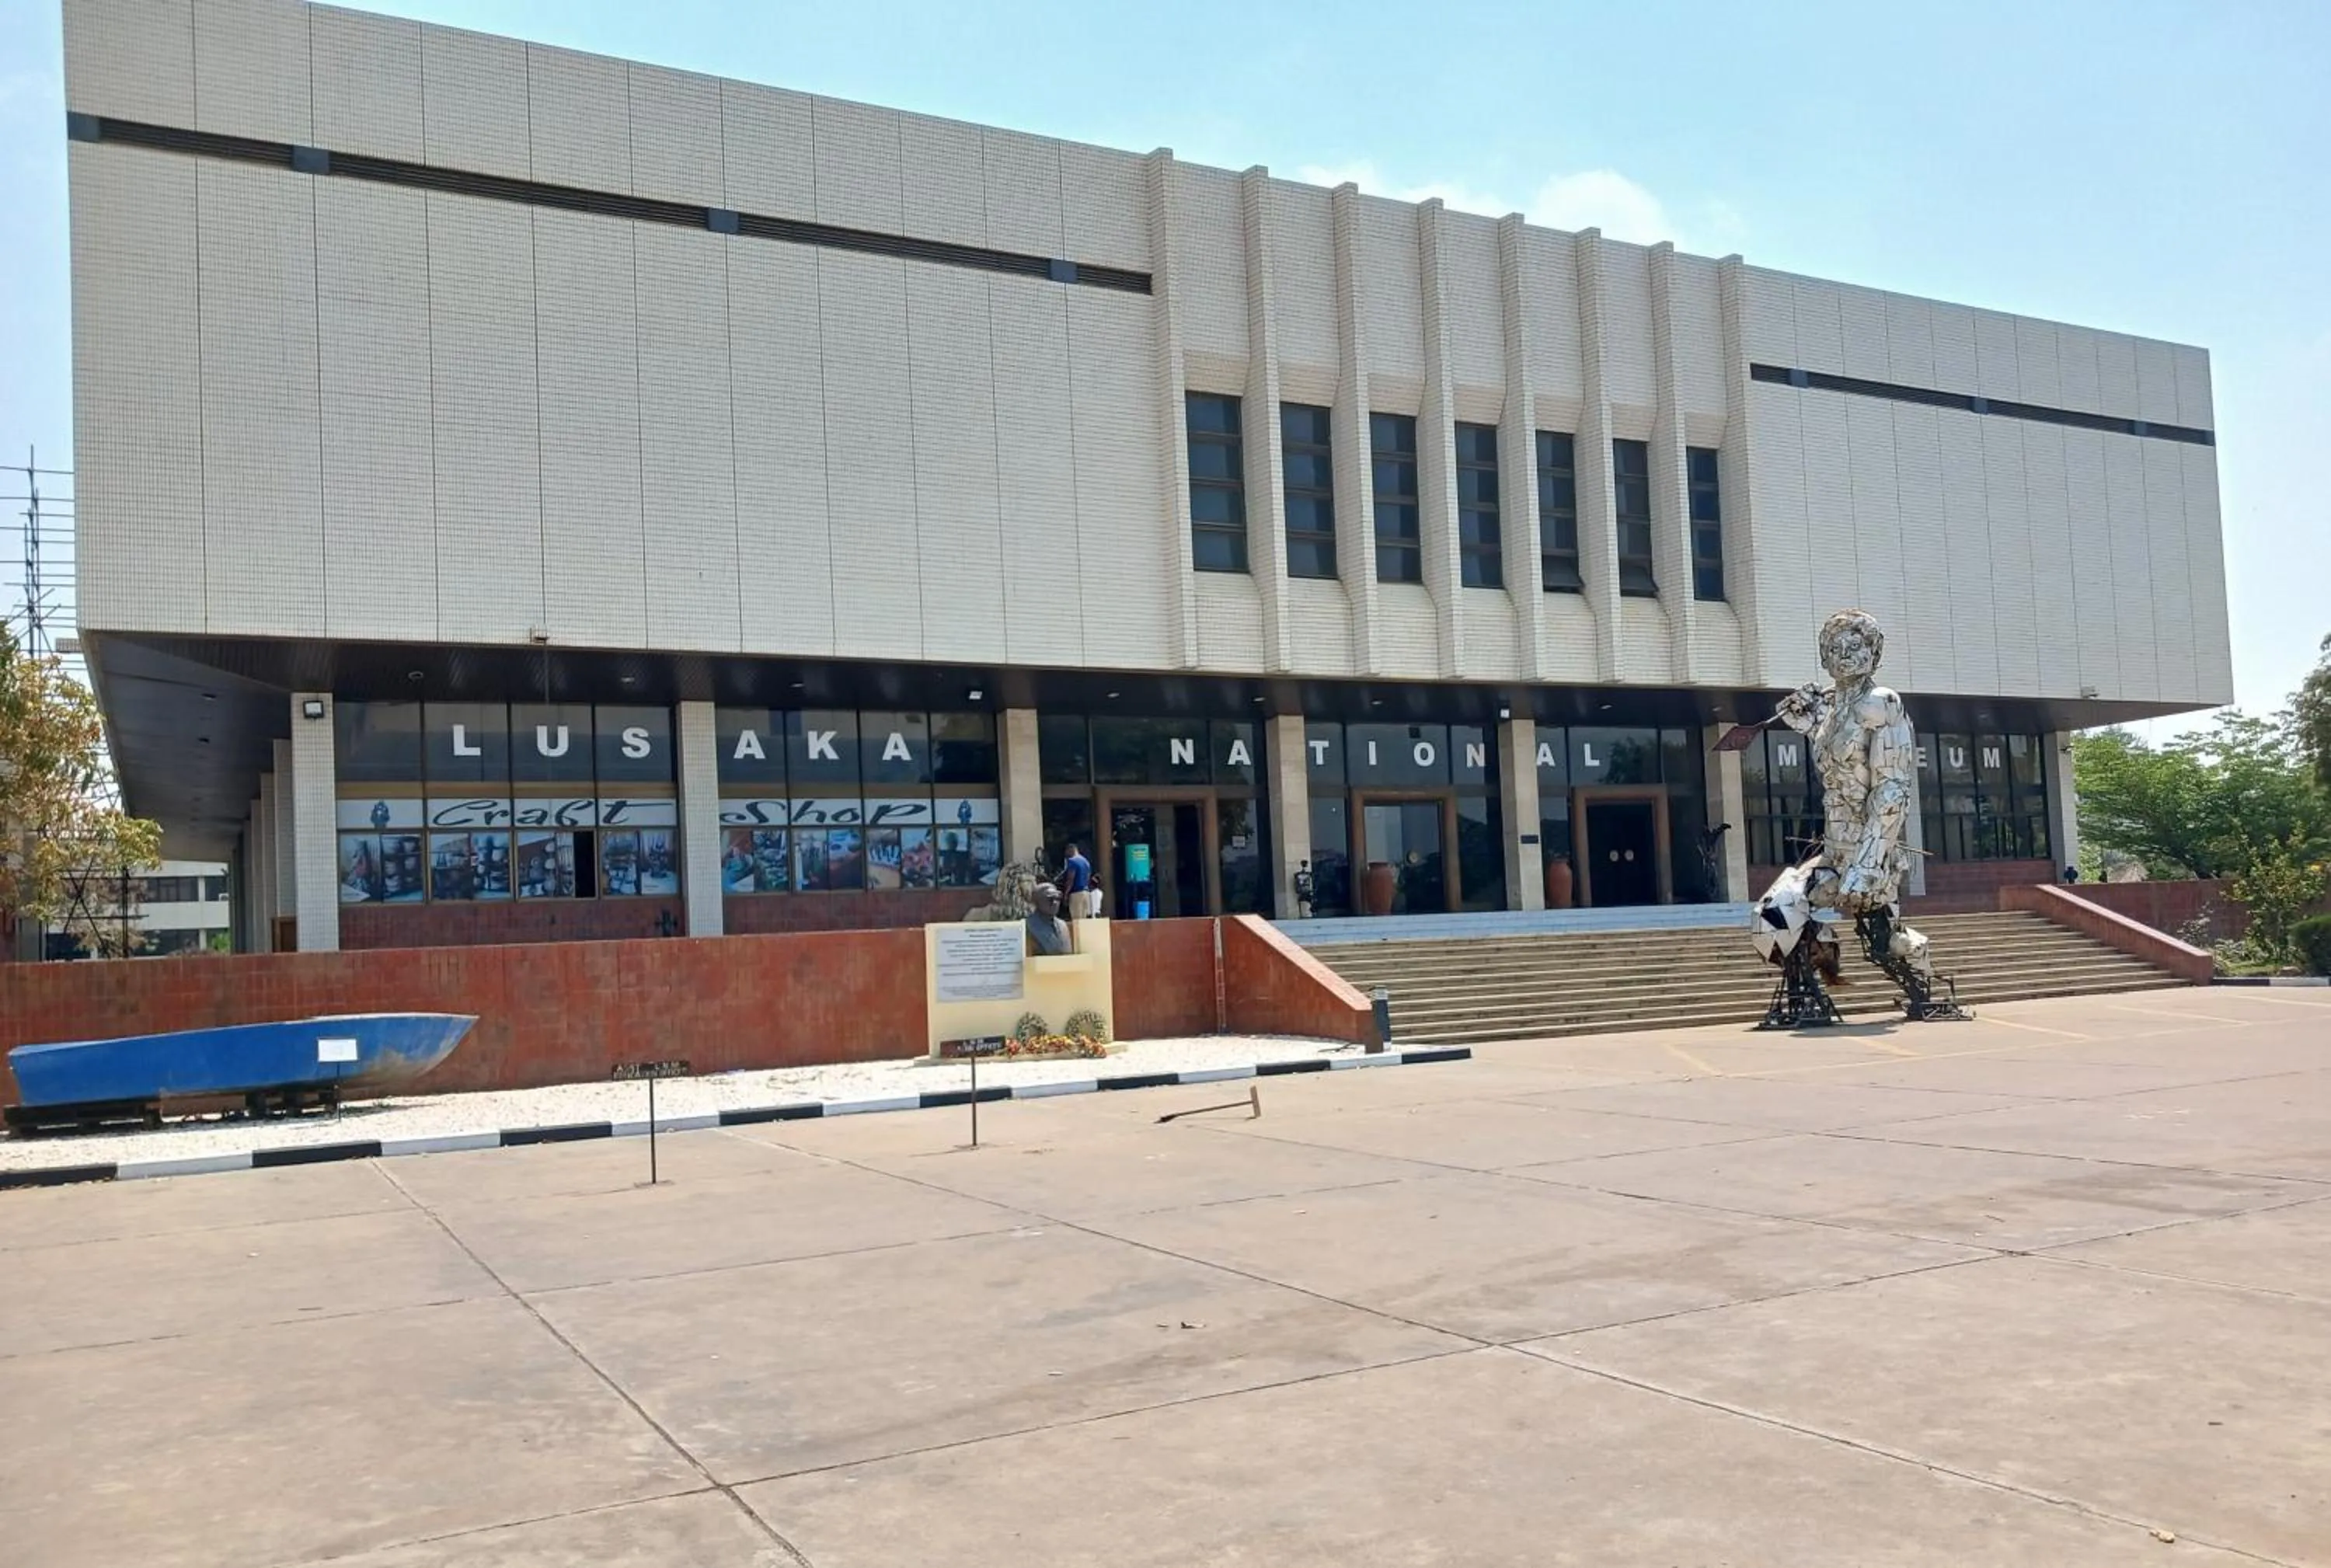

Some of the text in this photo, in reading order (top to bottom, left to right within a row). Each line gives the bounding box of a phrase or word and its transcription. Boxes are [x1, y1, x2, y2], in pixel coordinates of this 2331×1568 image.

[453, 724, 2001, 768] LUSAKA NATIONAL MEUM
[432, 800, 928, 827] Craft Shop
